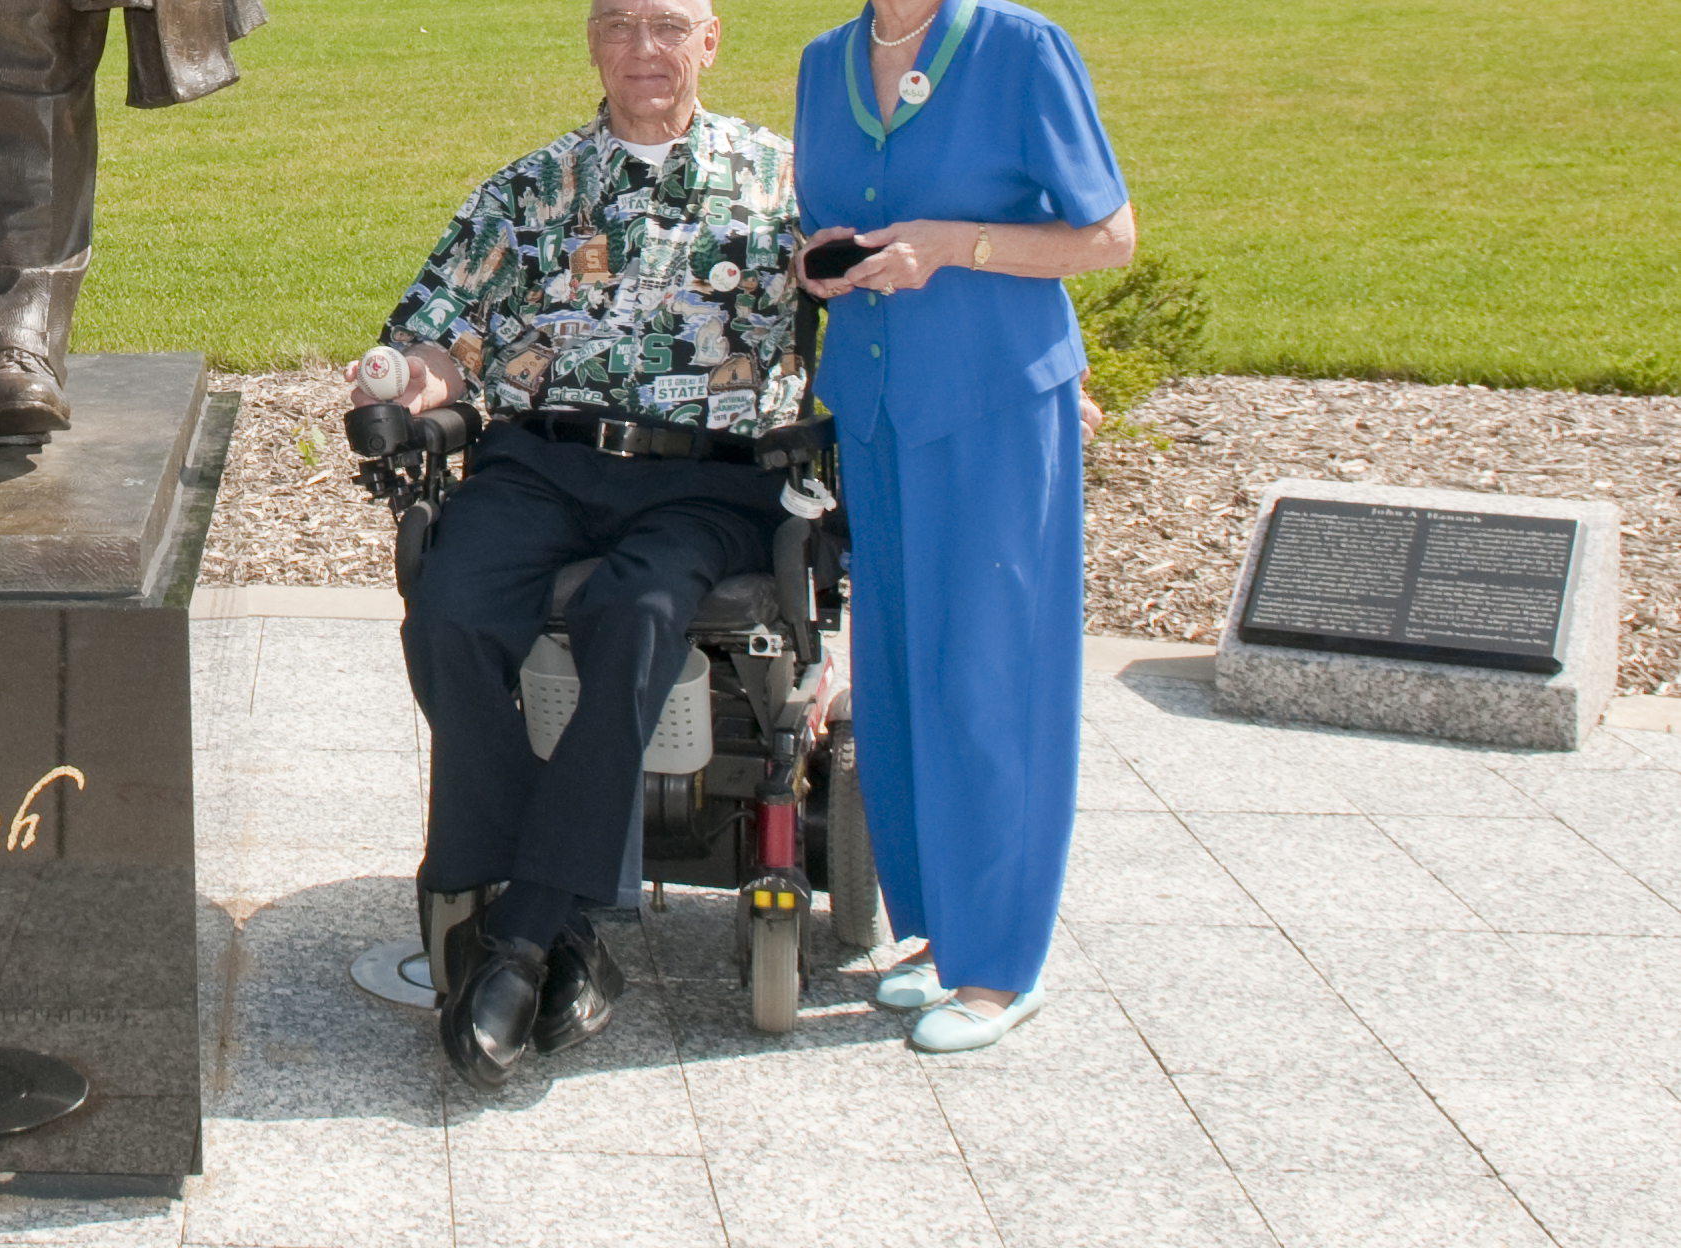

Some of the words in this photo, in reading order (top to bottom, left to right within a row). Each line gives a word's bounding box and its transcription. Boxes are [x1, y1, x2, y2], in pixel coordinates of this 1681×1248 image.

[706, 195, 732, 227] S
[547, 386, 604, 405] State
[658, 385, 705, 400] STATE
[1427, 512, 1482, 524] Hannah
